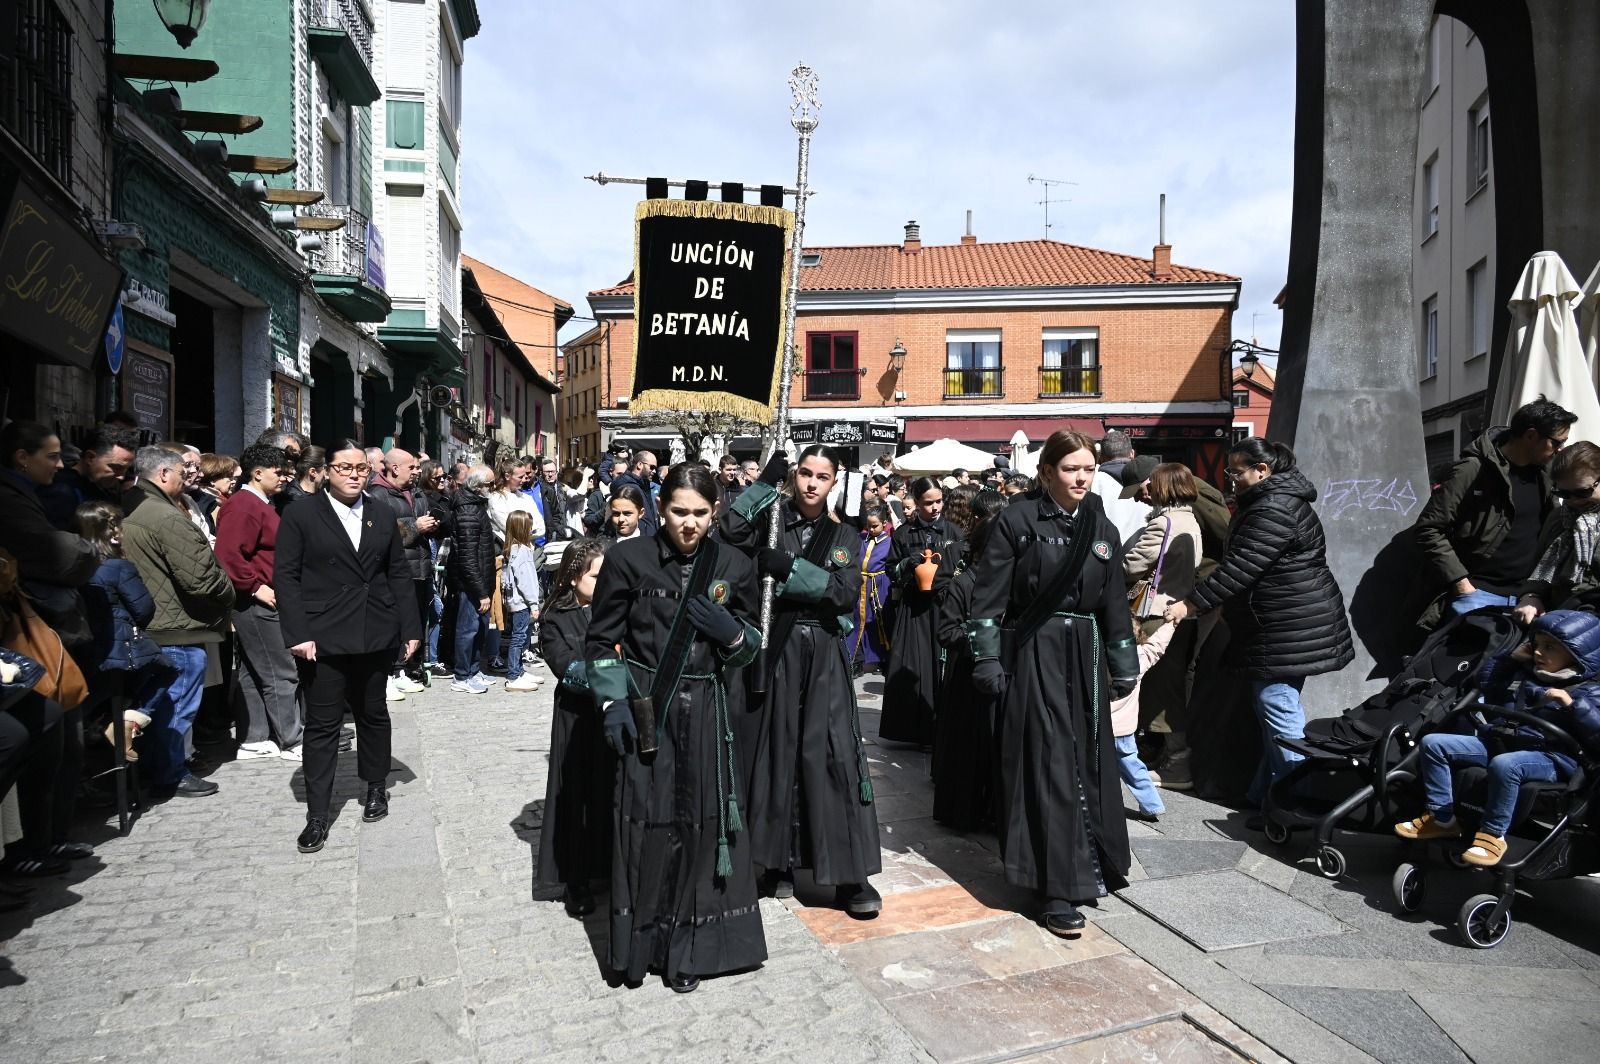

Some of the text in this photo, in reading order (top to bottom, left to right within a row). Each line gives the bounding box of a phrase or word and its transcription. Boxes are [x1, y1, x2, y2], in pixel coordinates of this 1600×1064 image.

[5, 239, 55, 302] La
[142, 284, 166, 309] PATIO
[694, 277, 725, 300] DE
[650, 310, 750, 341] BETANÍA
[792, 429, 813, 440] TATTOO
[871, 428, 896, 439] PIERCING
